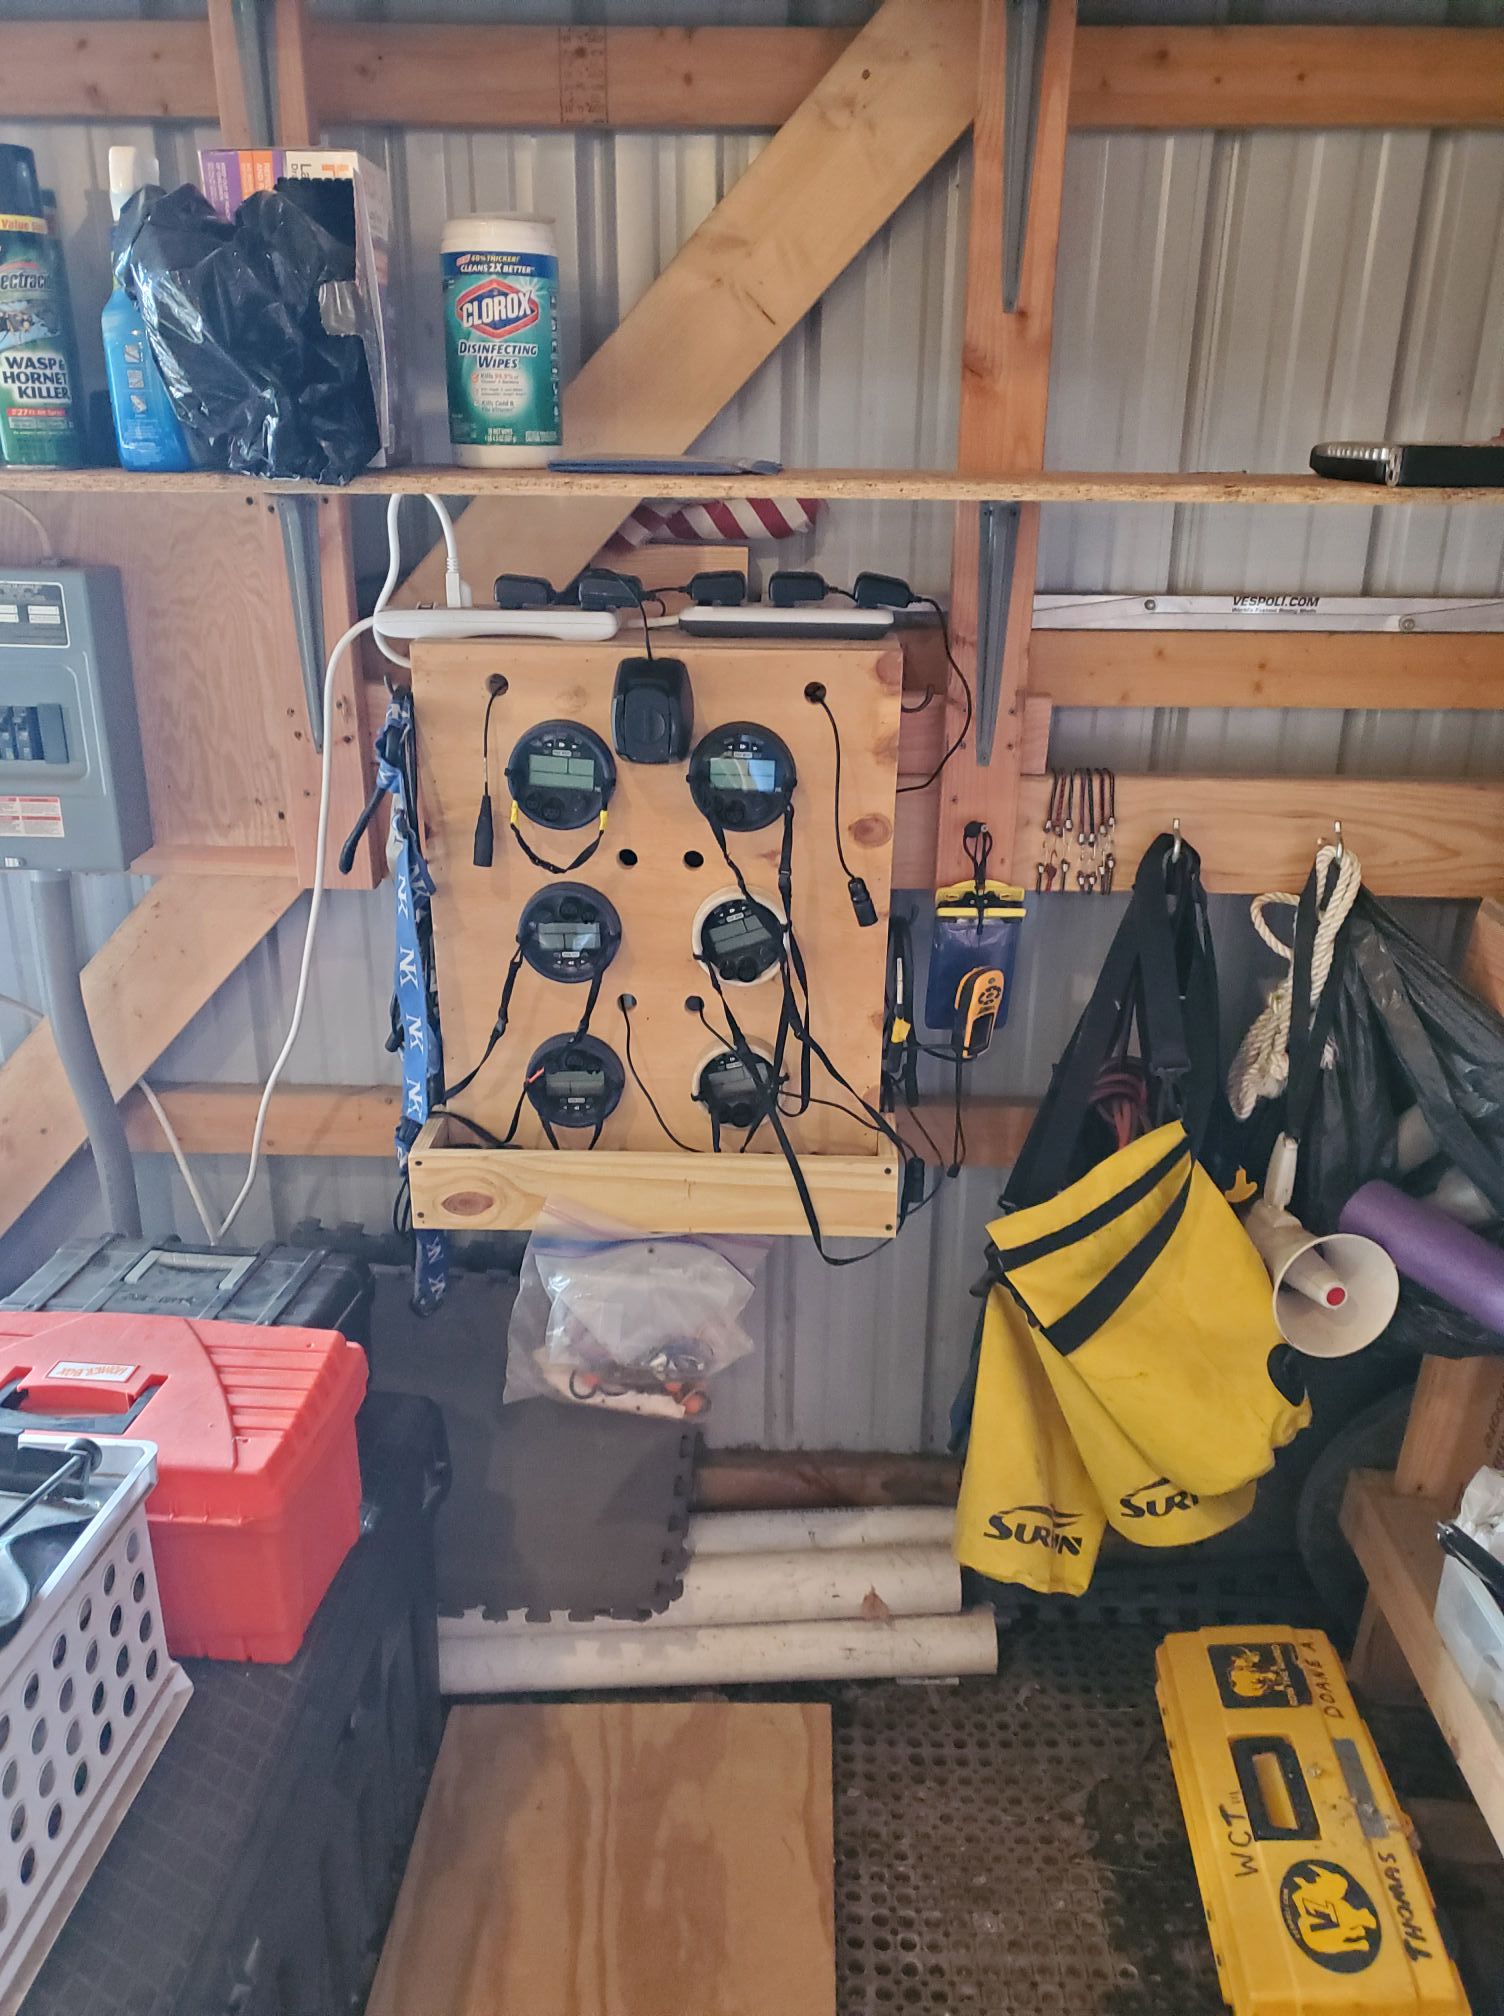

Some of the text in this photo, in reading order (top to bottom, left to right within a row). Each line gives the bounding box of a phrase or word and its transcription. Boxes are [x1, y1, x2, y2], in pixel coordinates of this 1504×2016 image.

[1, 219, 30, 230] Value
[460, 263, 488, 272] CLEANS
[489, 262, 502, 272] 2X
[462, 290, 532, 328] CLOROX
[459, 341, 538, 356] DISINFECTING
[5, 356, 57, 371] WASP
[478, 355, 518, 369] WIPES
[2, 371, 67, 385] HORNET
[17, 386, 71, 400] KILLER
[1233, 595, 1320, 607] VESPOLI.COM
[397, 874, 409, 919] NK
[400, 946, 419, 989] NK
[406, 1014, 424, 1054] NK
[406, 1079, 423, 1120] NK
[1218, 1803, 1258, 1877] WCT
[1377, 1851, 1433, 1962] THOMAS
